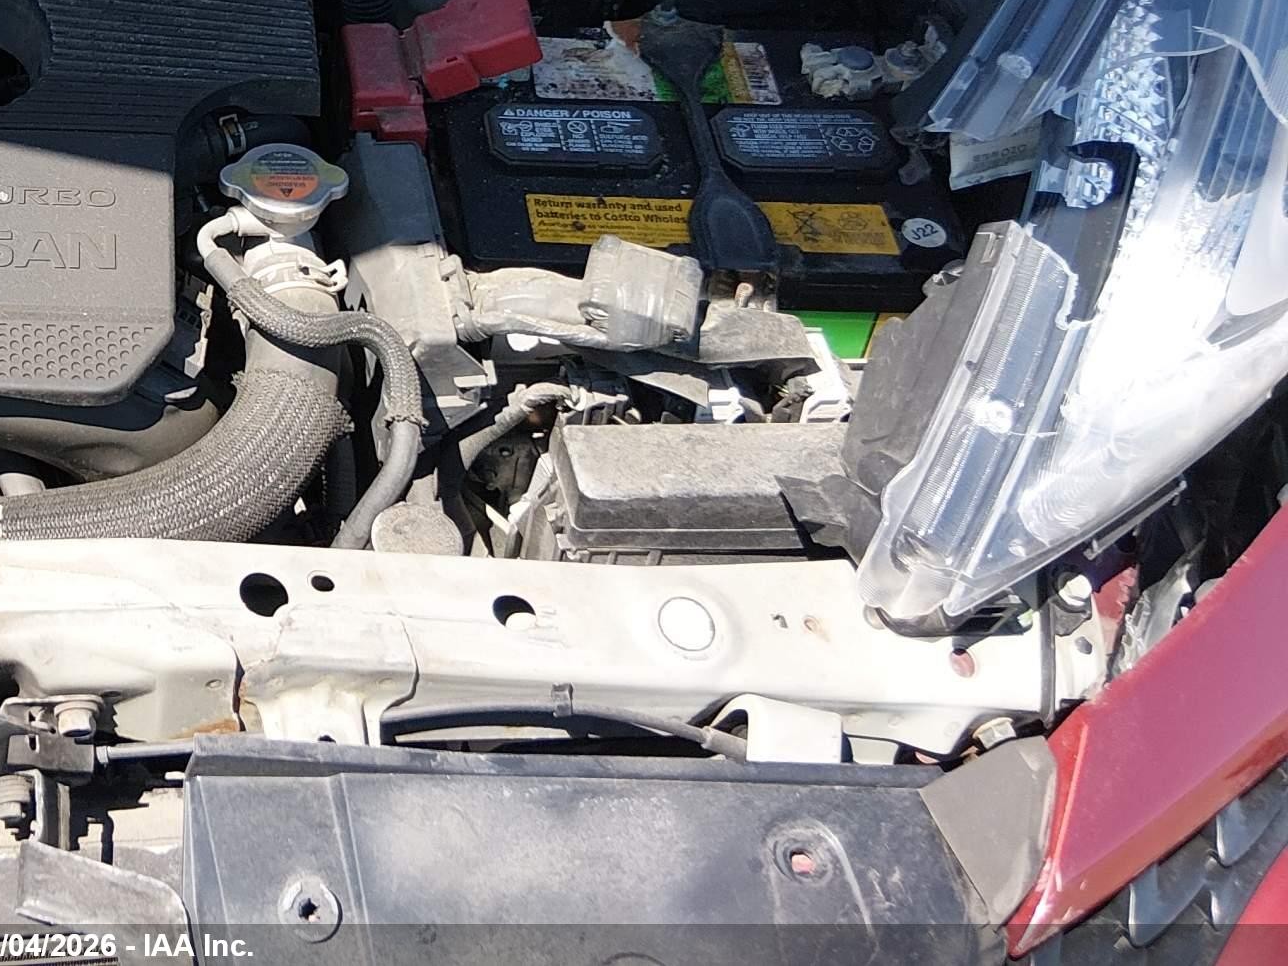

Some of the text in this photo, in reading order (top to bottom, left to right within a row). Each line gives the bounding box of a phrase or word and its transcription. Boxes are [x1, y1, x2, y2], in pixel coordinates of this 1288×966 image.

[516, 109, 570, 118] DANGER
[582, 110, 632, 119] POISON
[534, 198, 682, 212] Return warranty and used
[536, 209, 586, 221] batteries
[589, 212, 602, 221] to
[603, 212, 641, 223] Costco
[912, 223, 939, 242] J22
